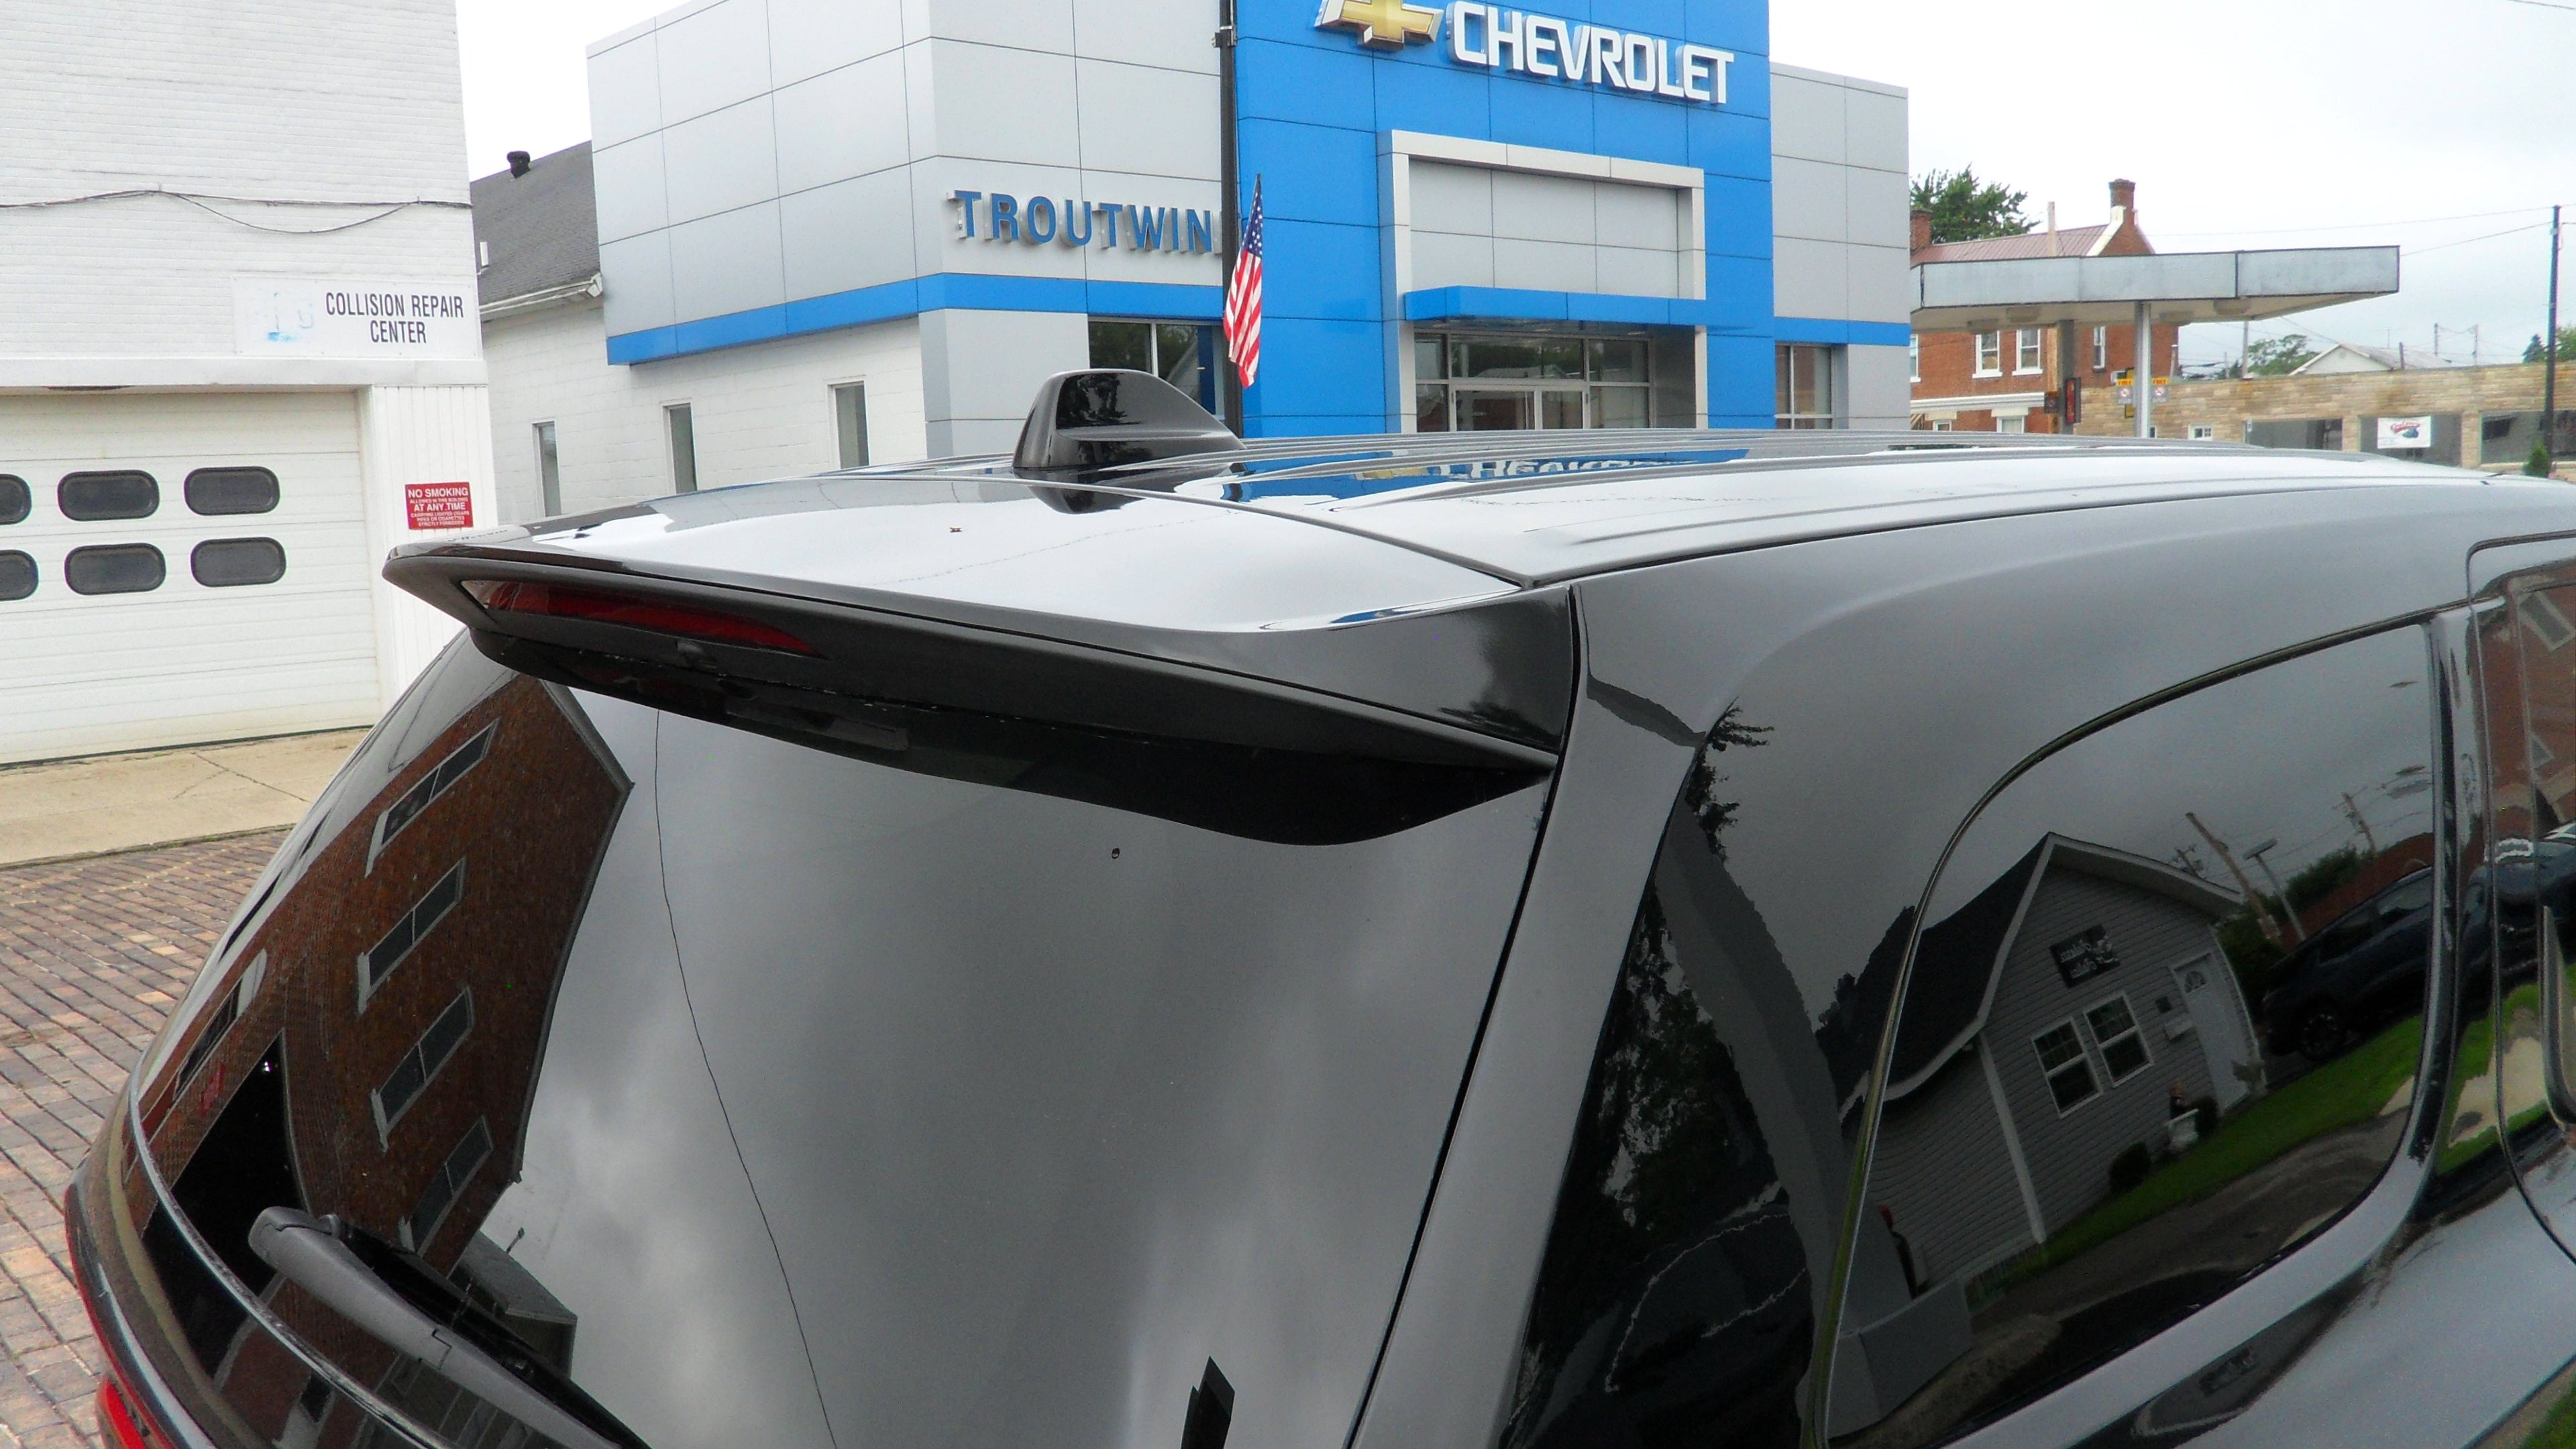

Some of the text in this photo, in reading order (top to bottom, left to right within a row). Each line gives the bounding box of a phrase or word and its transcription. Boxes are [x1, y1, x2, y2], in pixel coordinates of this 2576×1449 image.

[1447, 1, 1735, 105] CHEVROLET
[950, 189, 1221, 253] TROUTWIN
[326, 292, 405, 317] COLLISION
[411, 294, 464, 318] REPAIR
[370, 320, 427, 343] CENTER
[408, 487, 468, 498] NO SMOKING
[414, 502, 466, 512] AT ANY TIME
